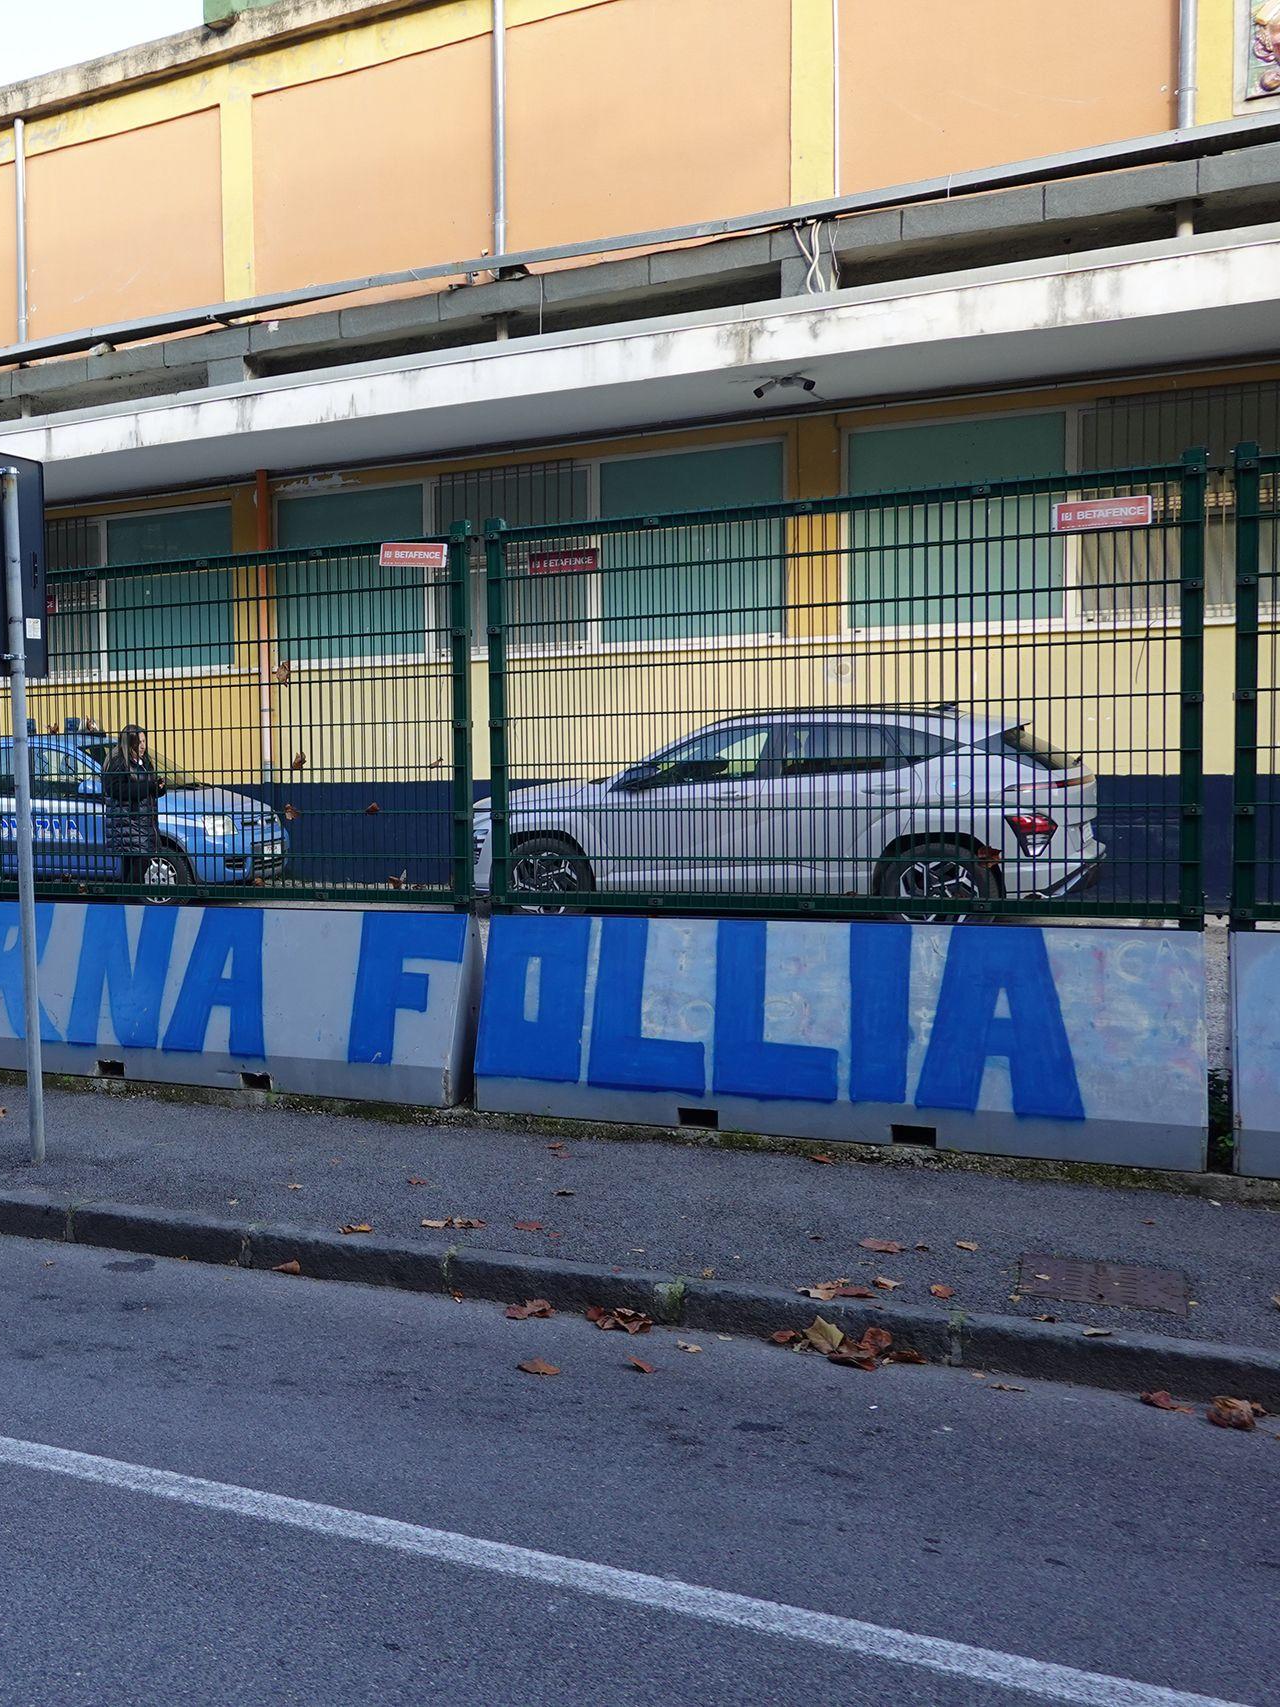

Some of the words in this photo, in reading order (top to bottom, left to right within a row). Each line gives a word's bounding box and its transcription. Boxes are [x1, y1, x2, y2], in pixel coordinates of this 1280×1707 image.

[1076, 505, 1145, 520] BETAFENCE
[394, 551, 441, 559] BETAFENCE
[348, 911, 1085, 1119] FOLLIA
